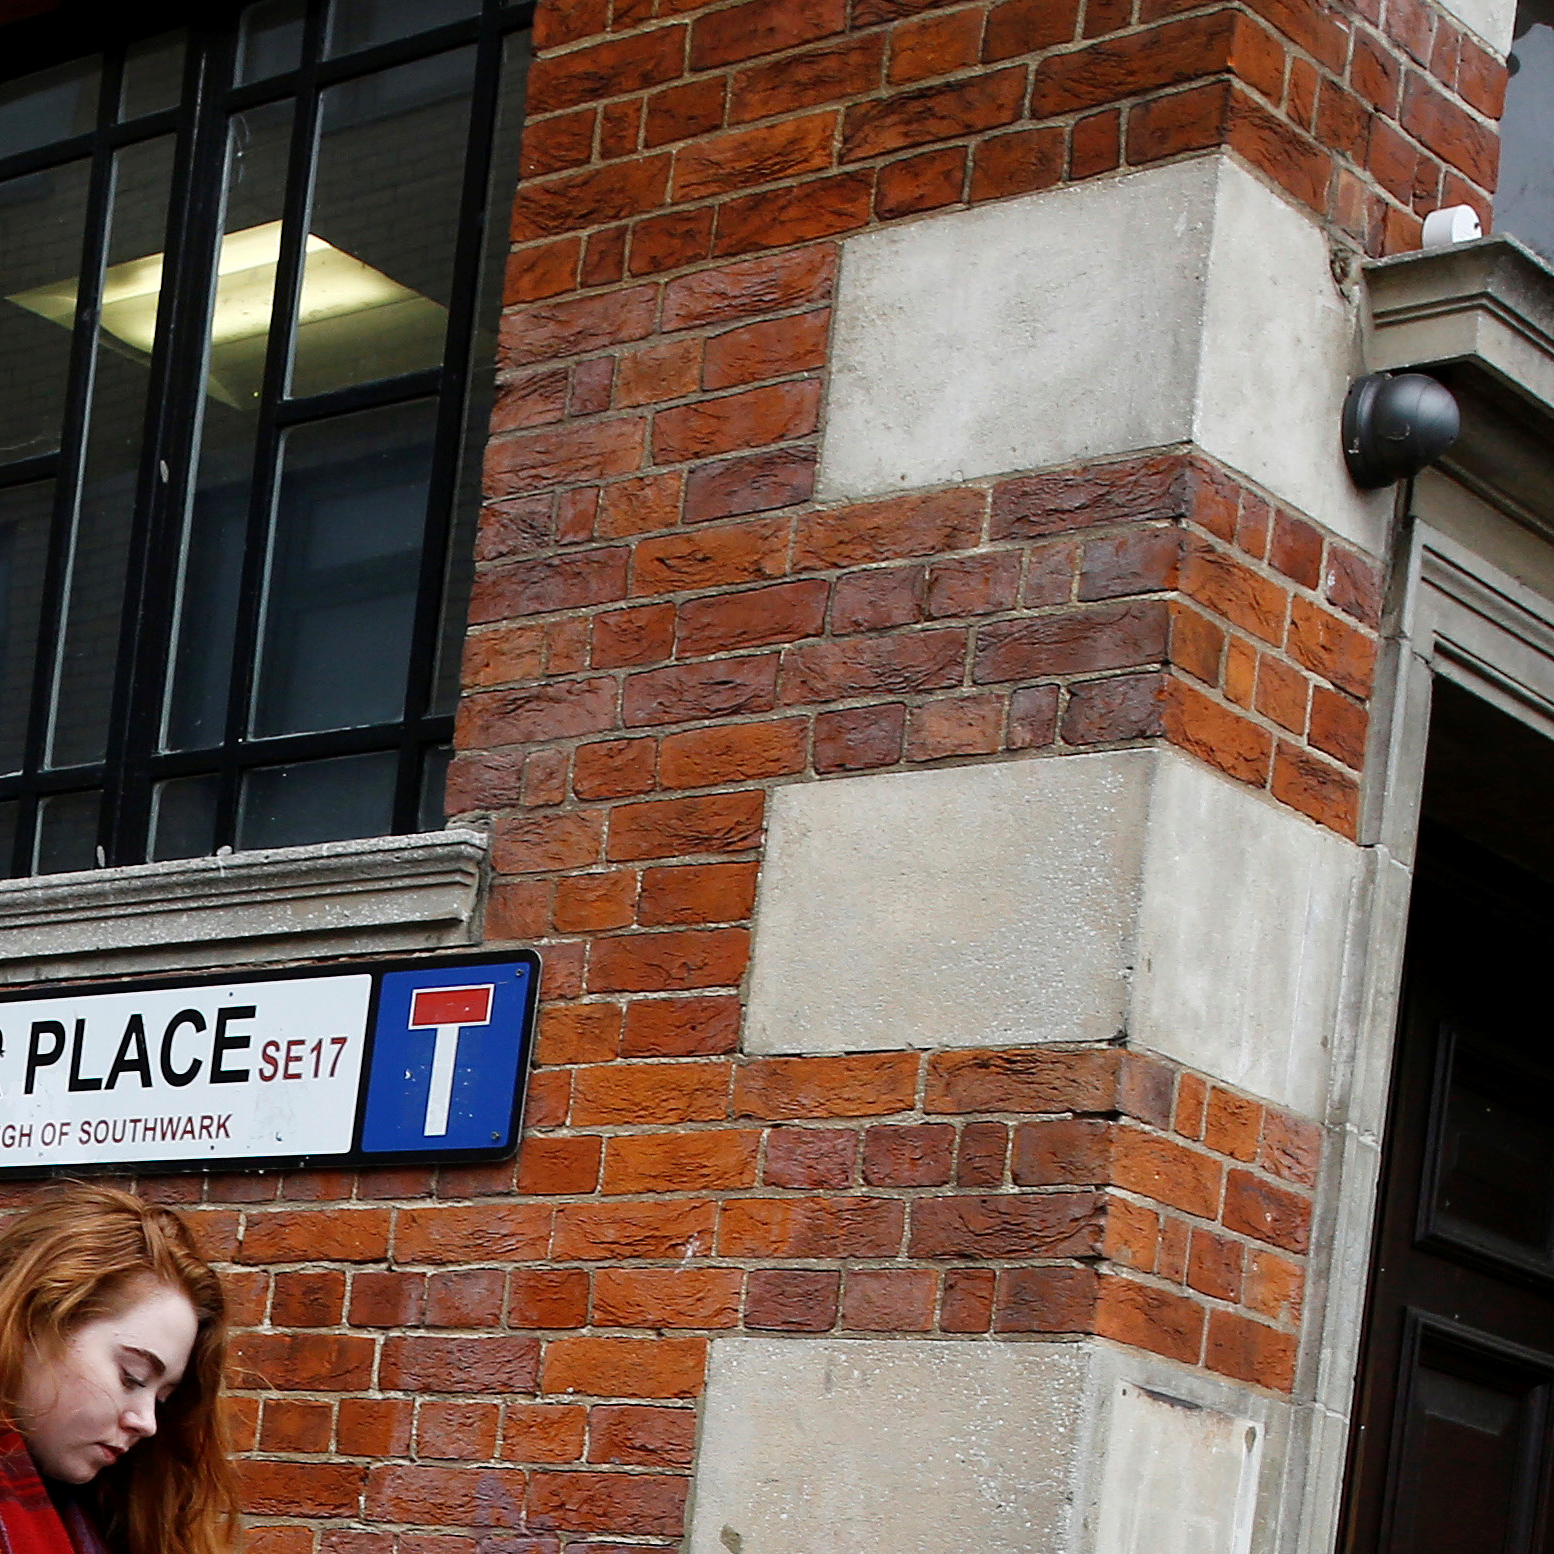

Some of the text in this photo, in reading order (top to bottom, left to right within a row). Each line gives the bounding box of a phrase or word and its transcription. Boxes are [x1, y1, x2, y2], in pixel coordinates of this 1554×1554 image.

[24, 1005, 257, 1094] PLACE
[258, 1036, 348, 1084] SE17
[41, 1121, 71, 1147] OF
[79, 1113, 232, 1145] SOUTHWARK
